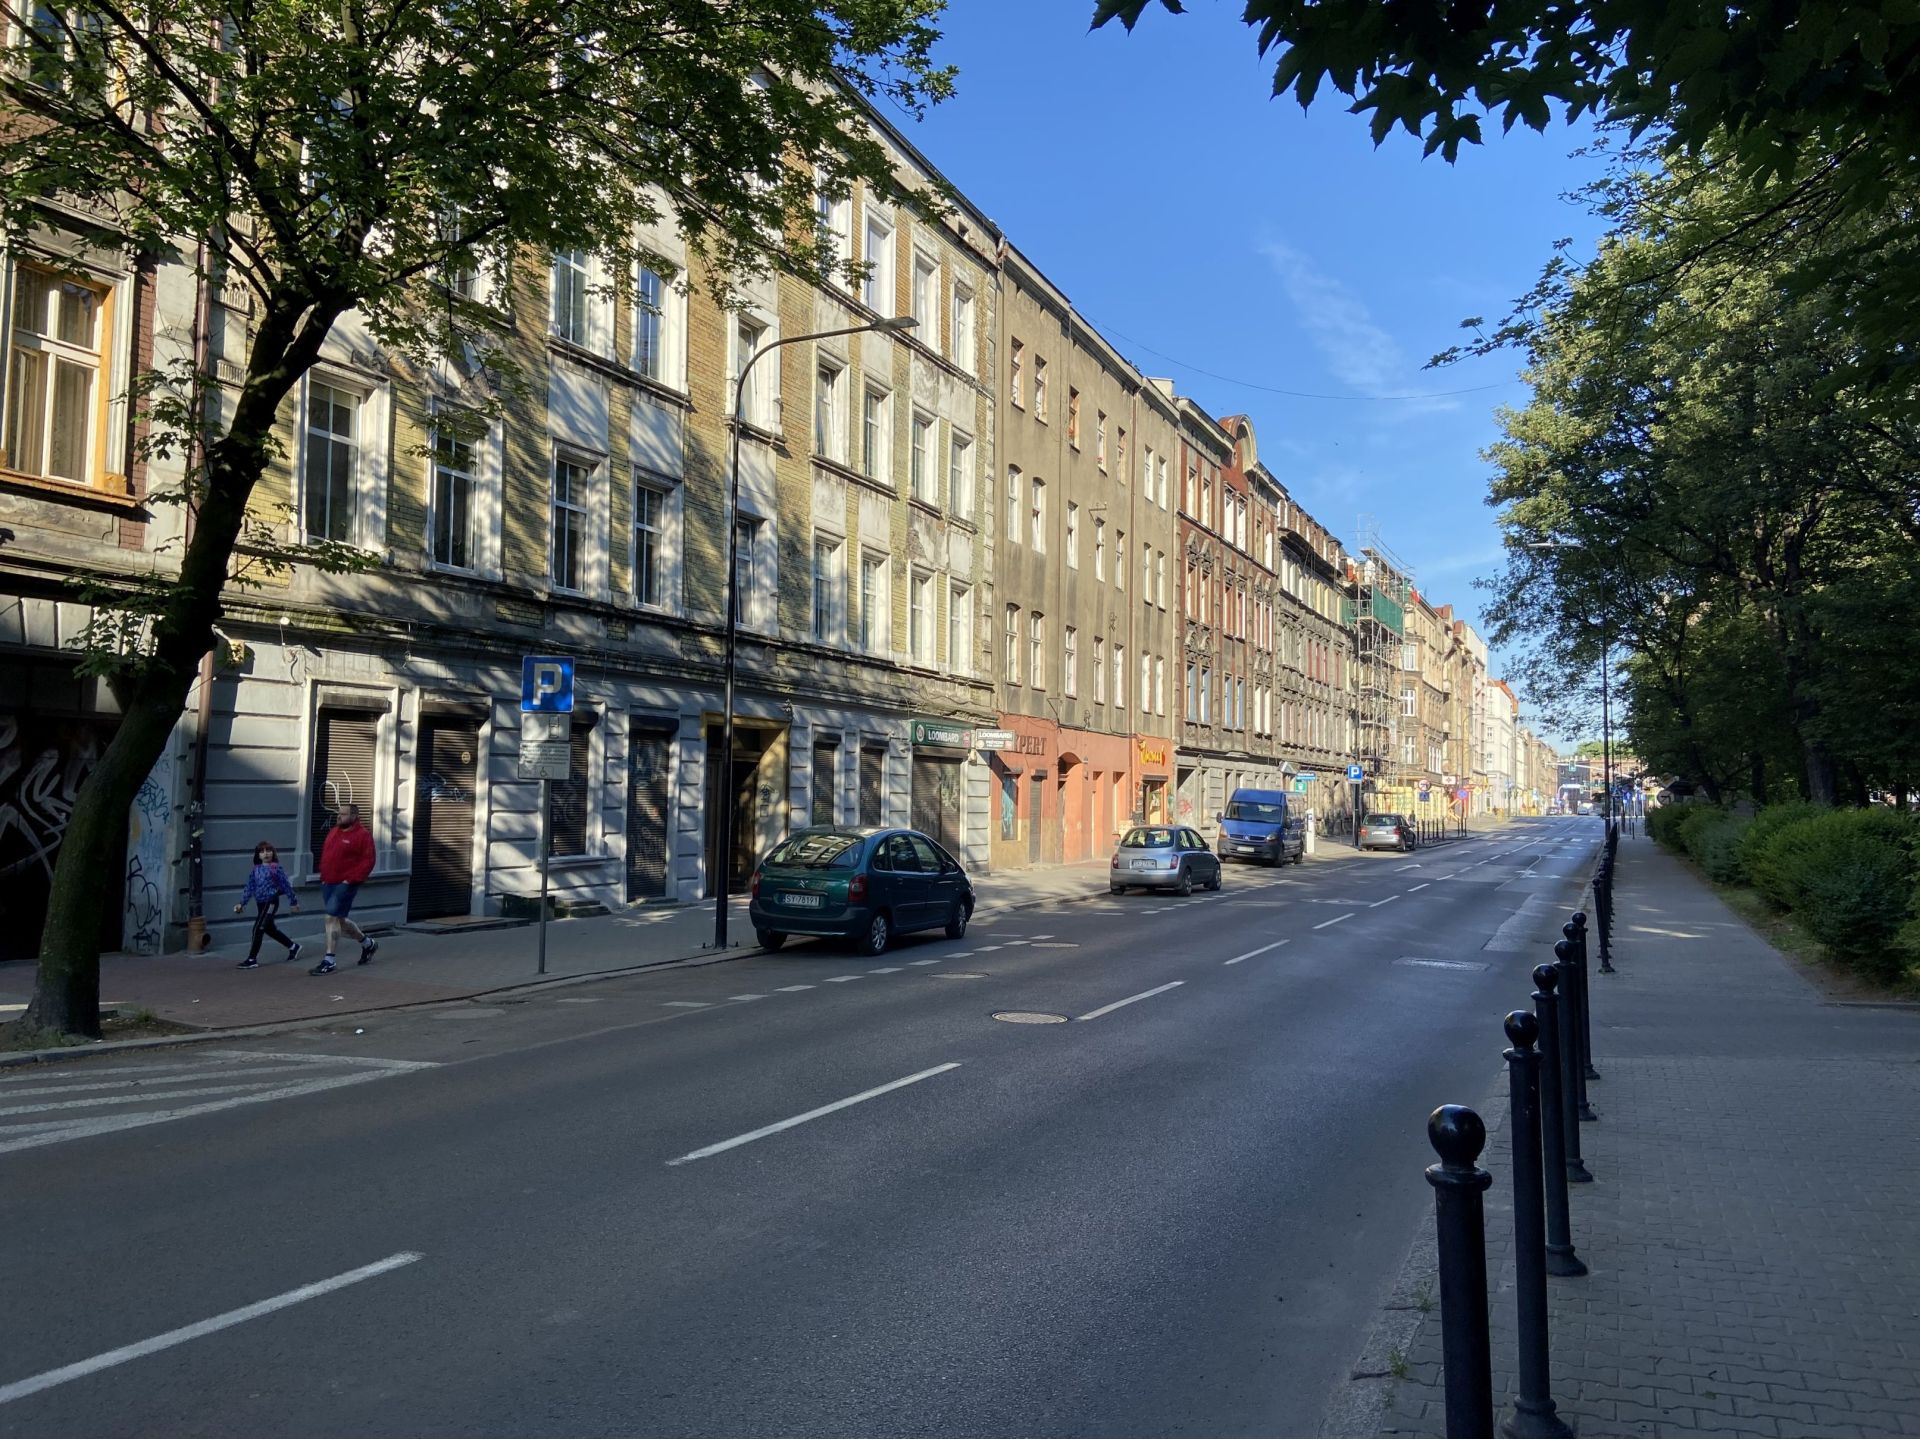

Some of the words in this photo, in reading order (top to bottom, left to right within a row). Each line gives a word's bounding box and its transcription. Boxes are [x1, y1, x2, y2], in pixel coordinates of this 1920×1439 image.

[533, 663, 562, 705] P
[928, 730, 959, 743] LOOMBARD
[1351, 766, 1359, 777] P
